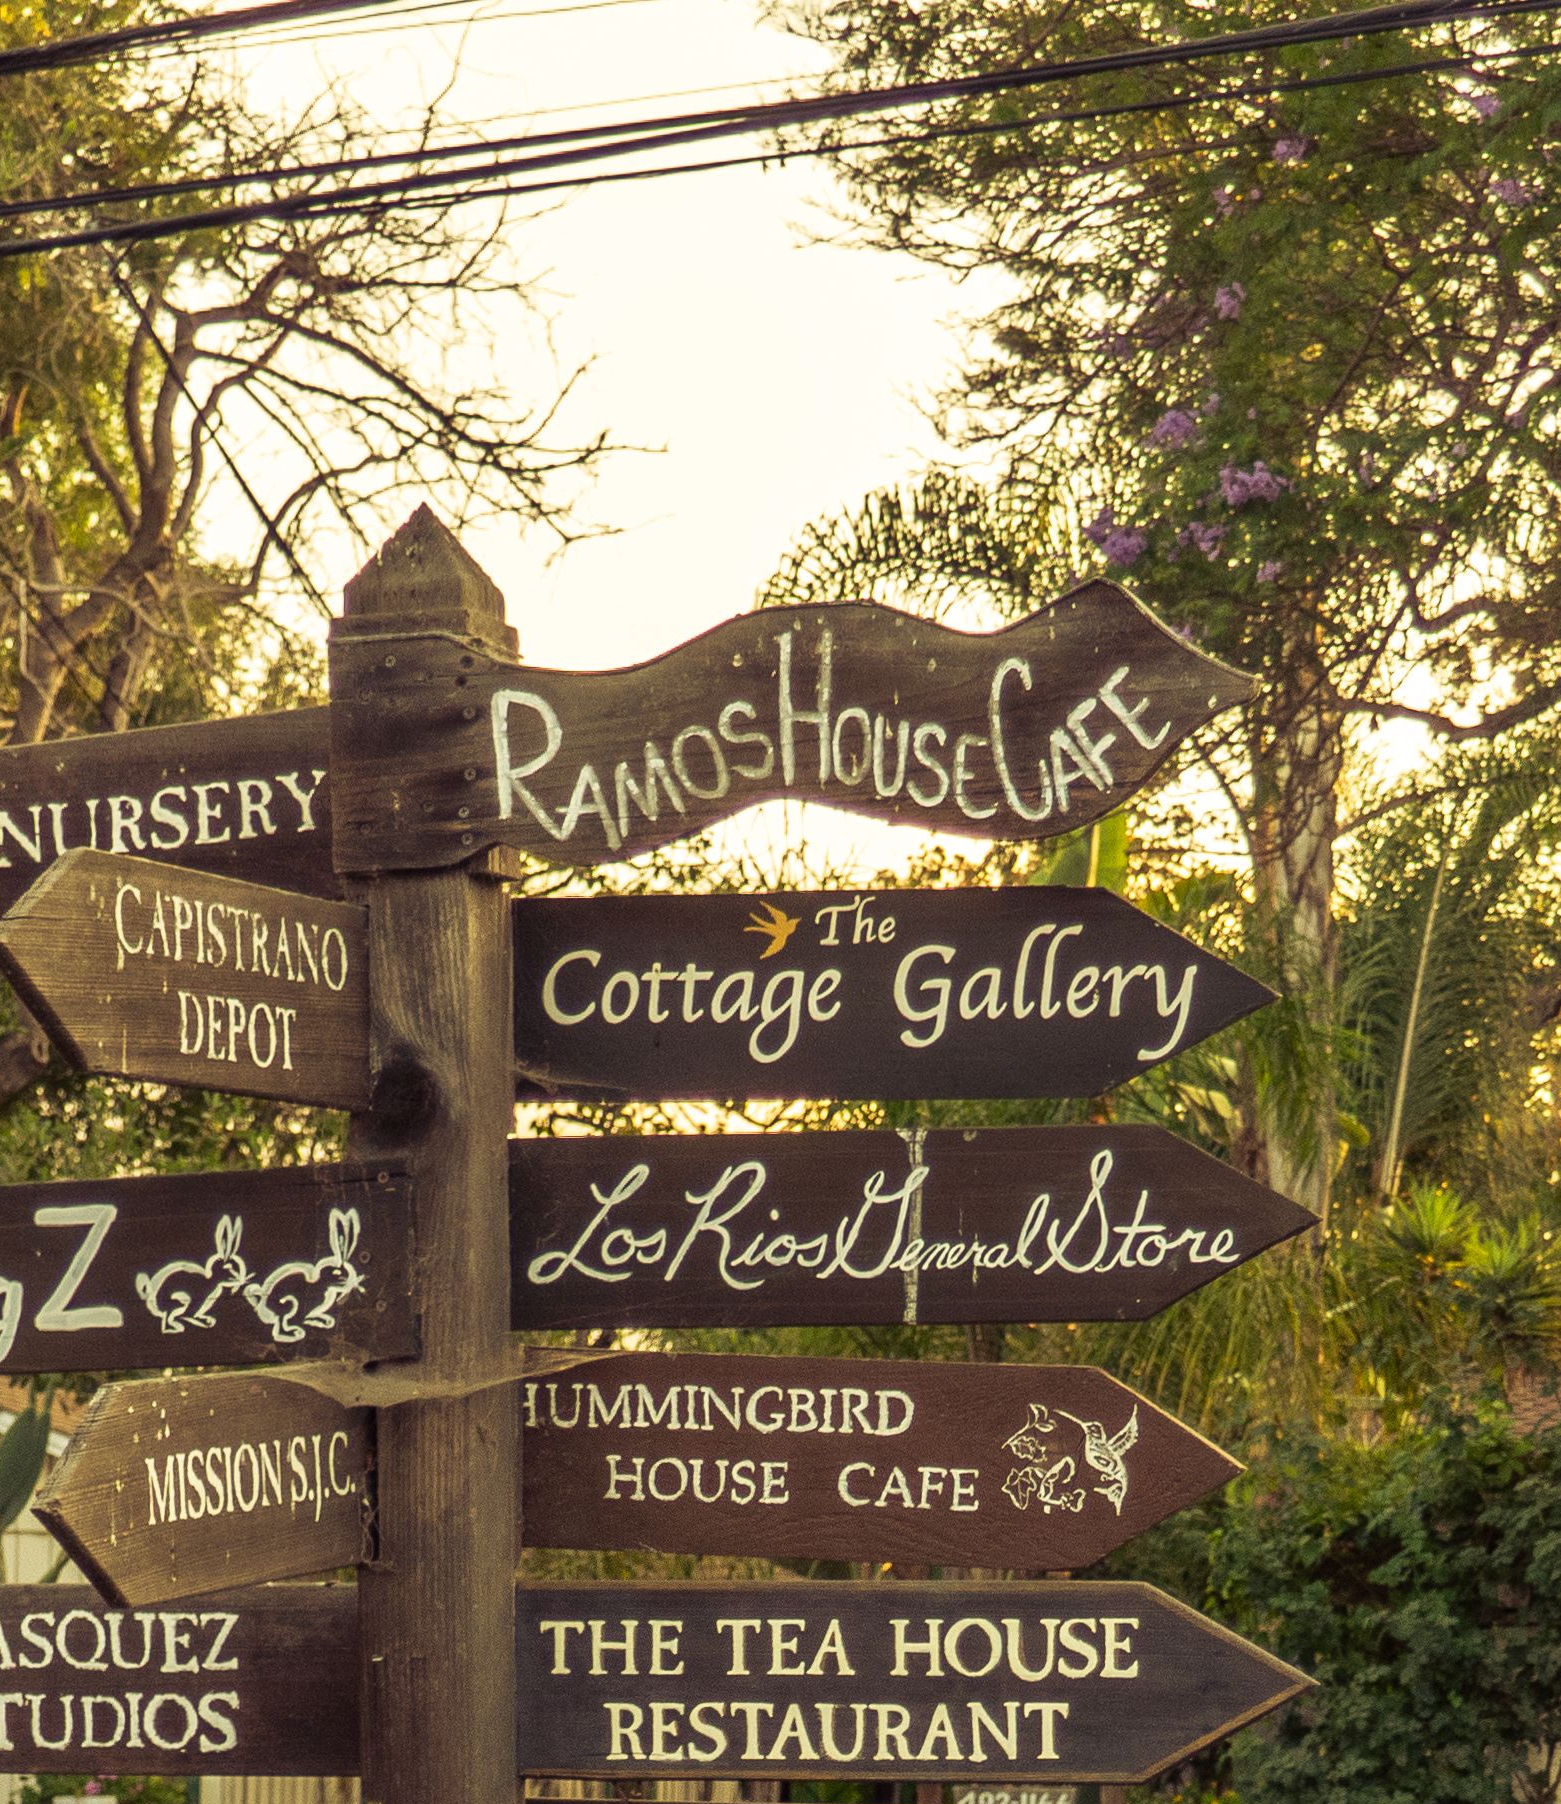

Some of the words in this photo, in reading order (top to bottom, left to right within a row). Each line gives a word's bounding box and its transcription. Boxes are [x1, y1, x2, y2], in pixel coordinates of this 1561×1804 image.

[491, 688, 774, 850] RAMOS
[778, 629, 997, 818] HOUSE
[990, 657, 1172, 821] CAFE
[114, 884, 348, 992] CAPISTRANO
[815, 894, 897, 948] The
[177, 991, 297, 1072] DEPOT
[541, 949, 843, 1064] Cottage
[893, 923, 1199, 1062] Gallery
[34, 1204, 124, 1332] Z
[527, 1164, 667, 1285] Los
[664, 1160, 830, 1290] Rios
[816, 1166, 1050, 1280] General
[1034, 1149, 1241, 1275] Store
[144, 1443, 282, 1527] MISSION
[290, 1430, 358, 1525] S.J.C.
[605, 1454, 789, 1506] HOUSE
[837, 1462, 980, 1513] CAFE
[539, 1619, 685, 1678] THE
[715, 1618, 855, 1678] TEA
[889, 1617, 1141, 1682] HOUSE
[604, 1701, 1070, 1764] RESTAURANT
